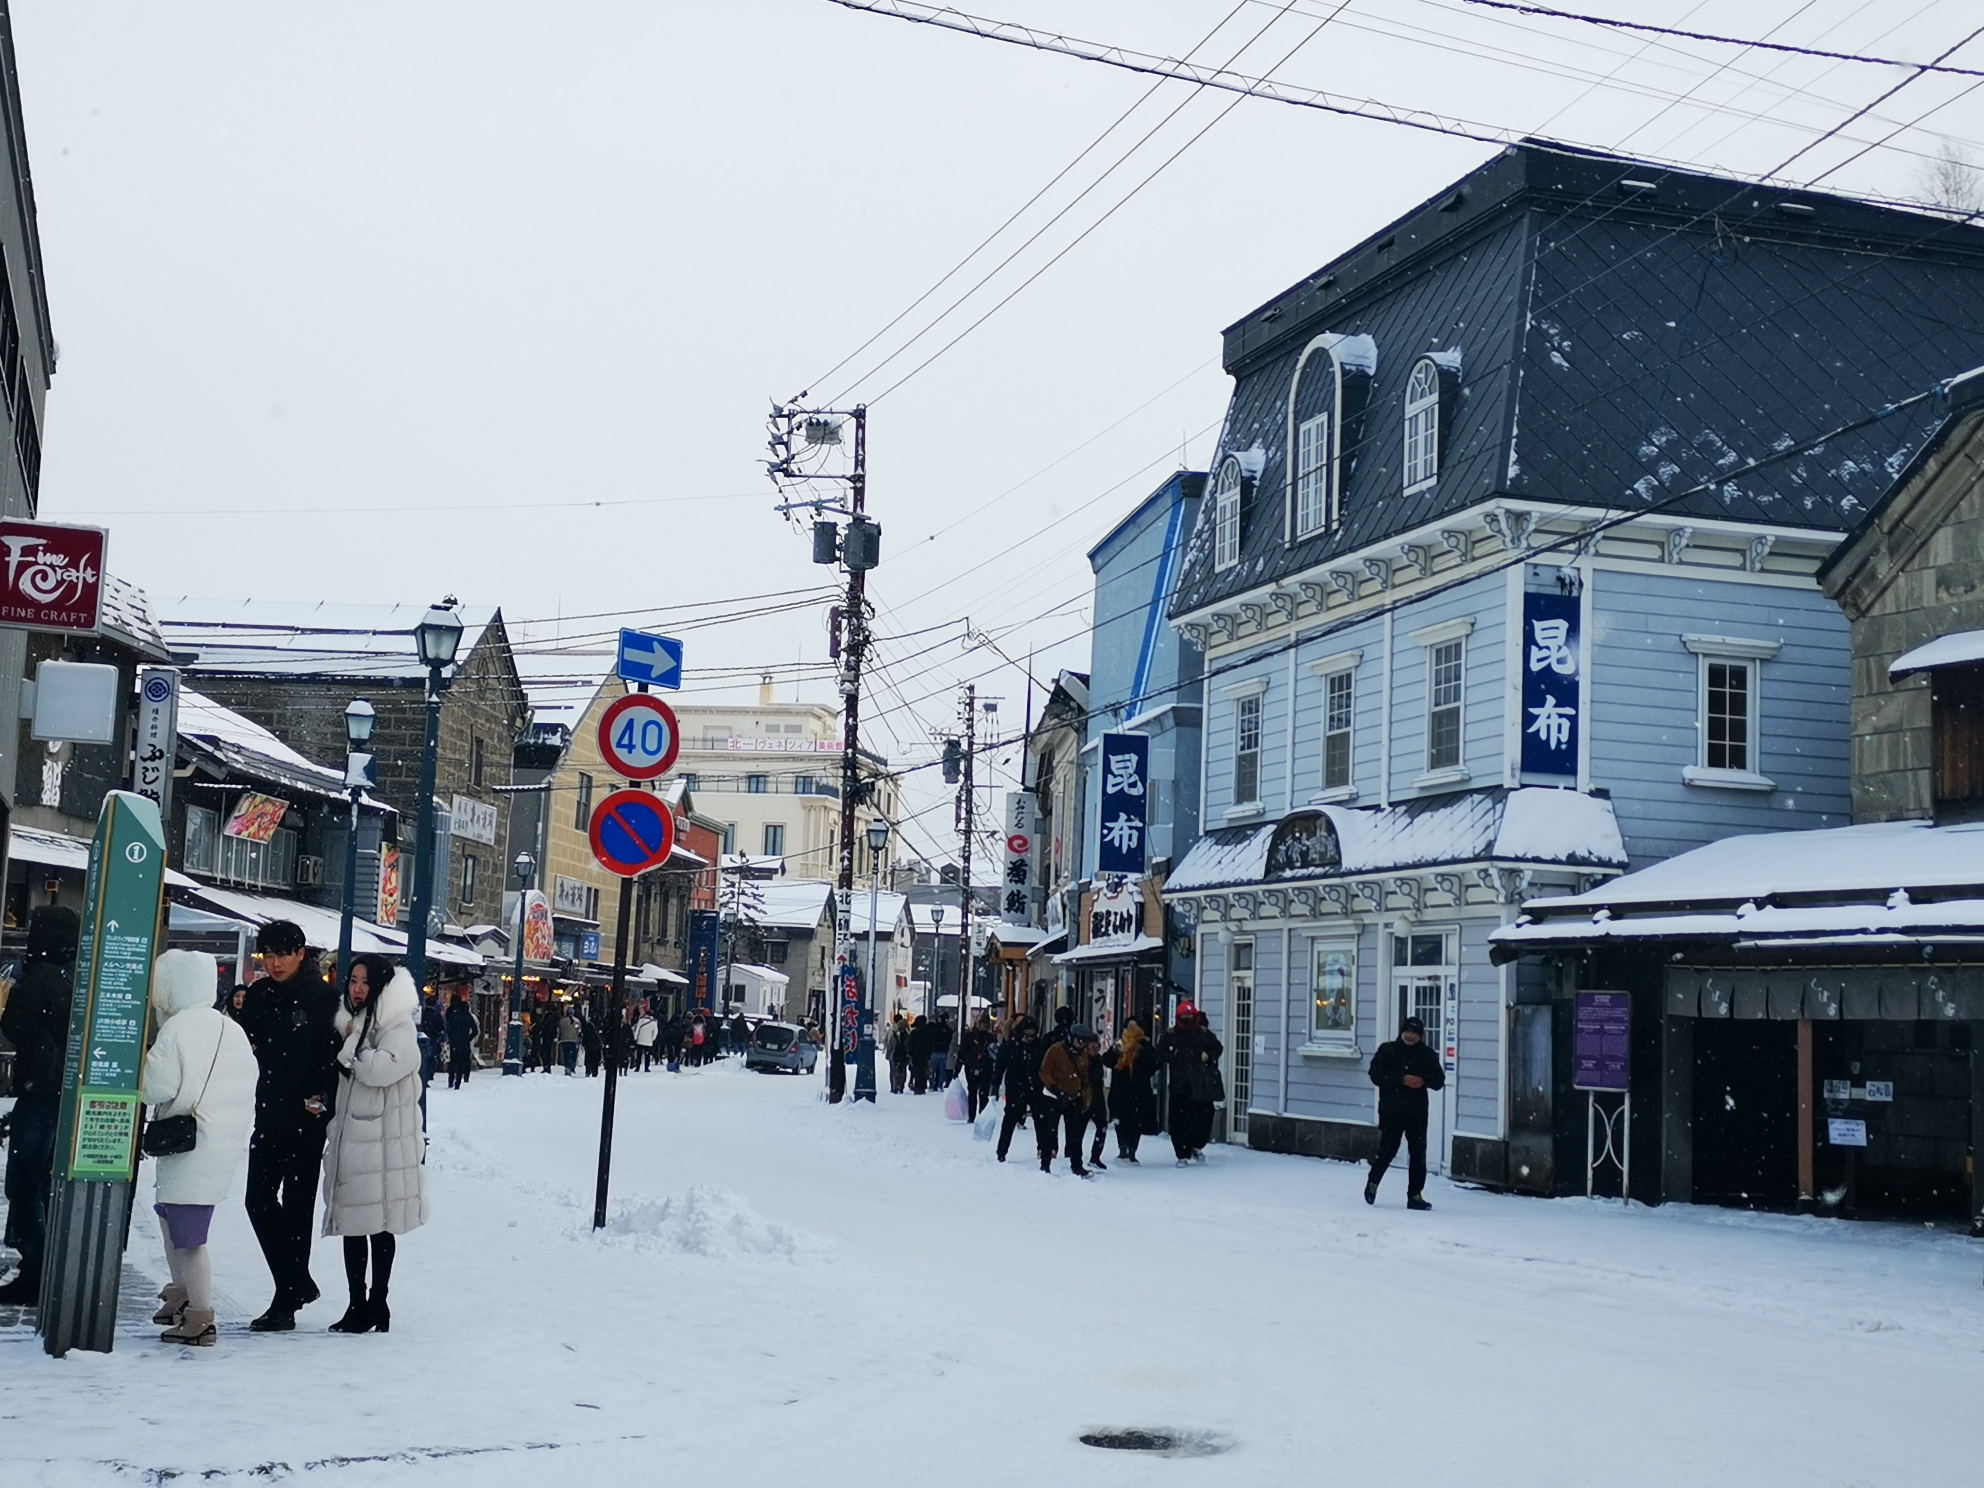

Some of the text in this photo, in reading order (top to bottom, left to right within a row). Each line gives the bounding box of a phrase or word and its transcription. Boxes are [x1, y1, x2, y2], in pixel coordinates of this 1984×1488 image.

[0, 535, 69, 591] Fine
[19, 551, 97, 606] Craft
[2, 606, 87, 623] FINE CRAFT
[1526, 618, 1577, 751] 昆布
[615, 717, 663, 757] 40
[1103, 752, 1145, 855] 昆布
